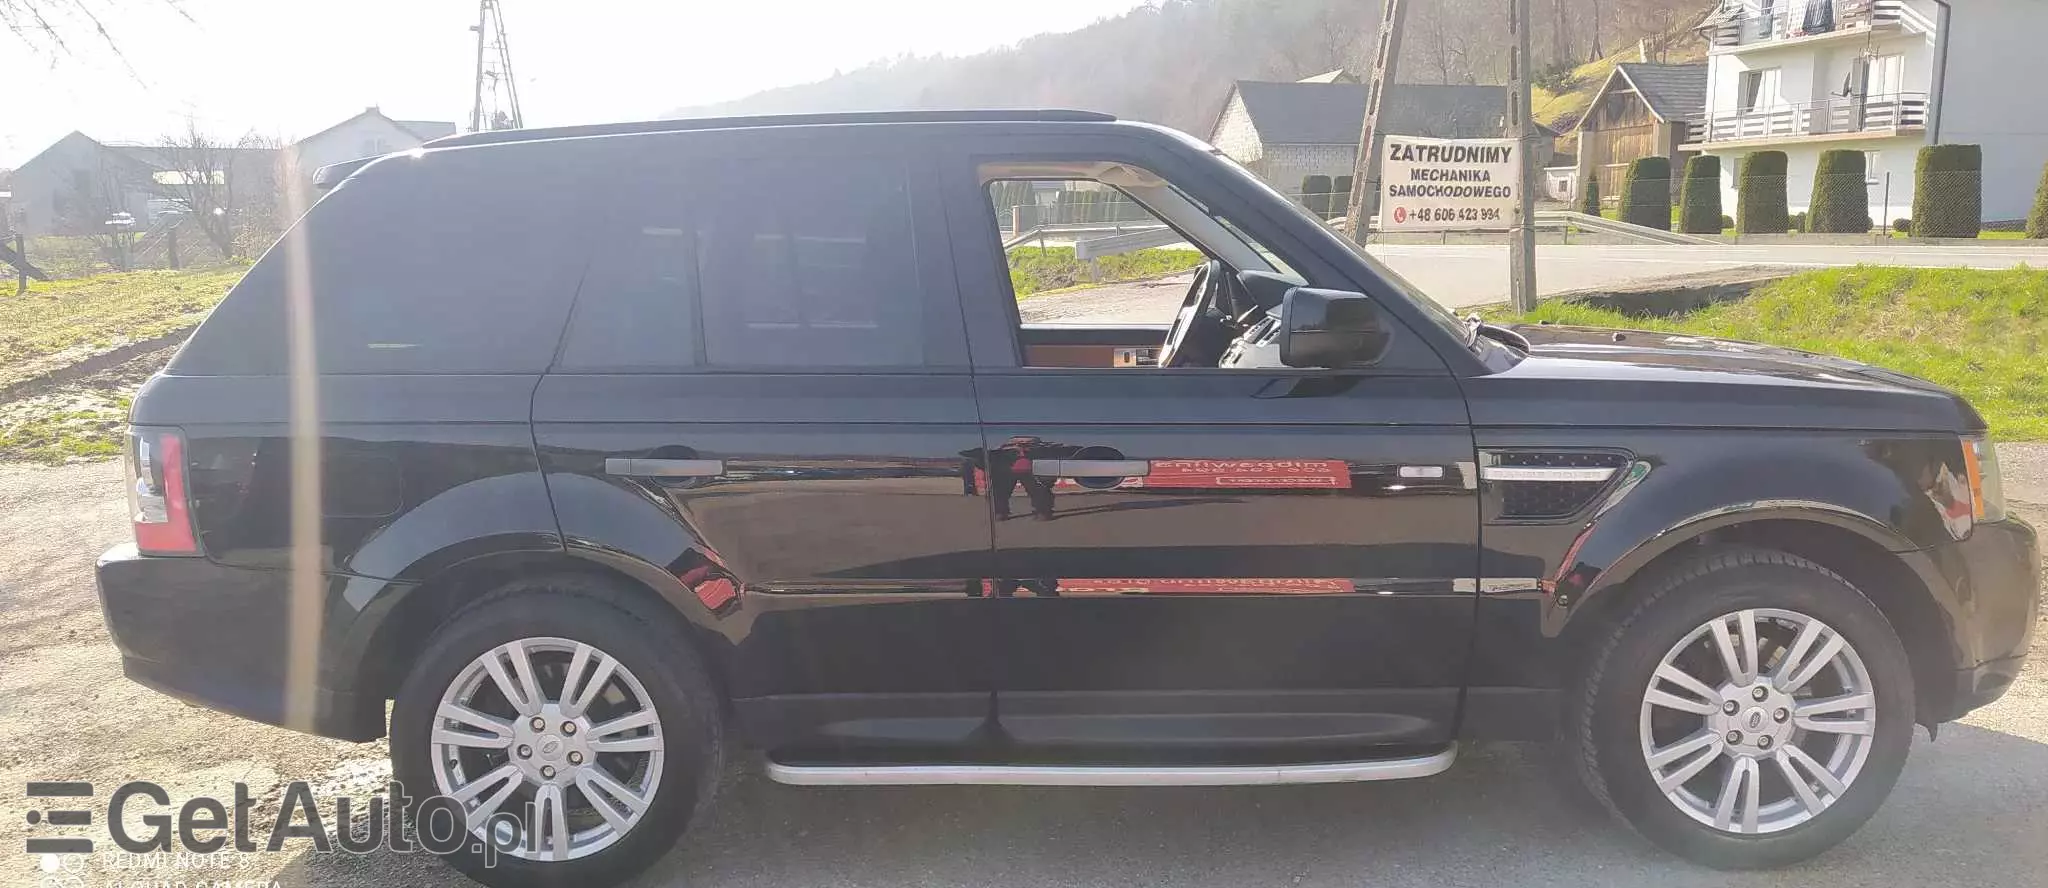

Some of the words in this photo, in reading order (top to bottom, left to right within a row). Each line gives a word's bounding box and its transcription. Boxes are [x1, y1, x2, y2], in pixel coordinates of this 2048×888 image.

[1390, 144, 1512, 163] ZATRUDNIMY
[1411, 168, 1490, 182] MECHANIKA
[1389, 185, 1511, 198] SAMOCHODOWEGO
[1409, 208, 1431, 221] +48
[1434, 208, 1455, 221] 606
[1458, 208, 1478, 220] 423
